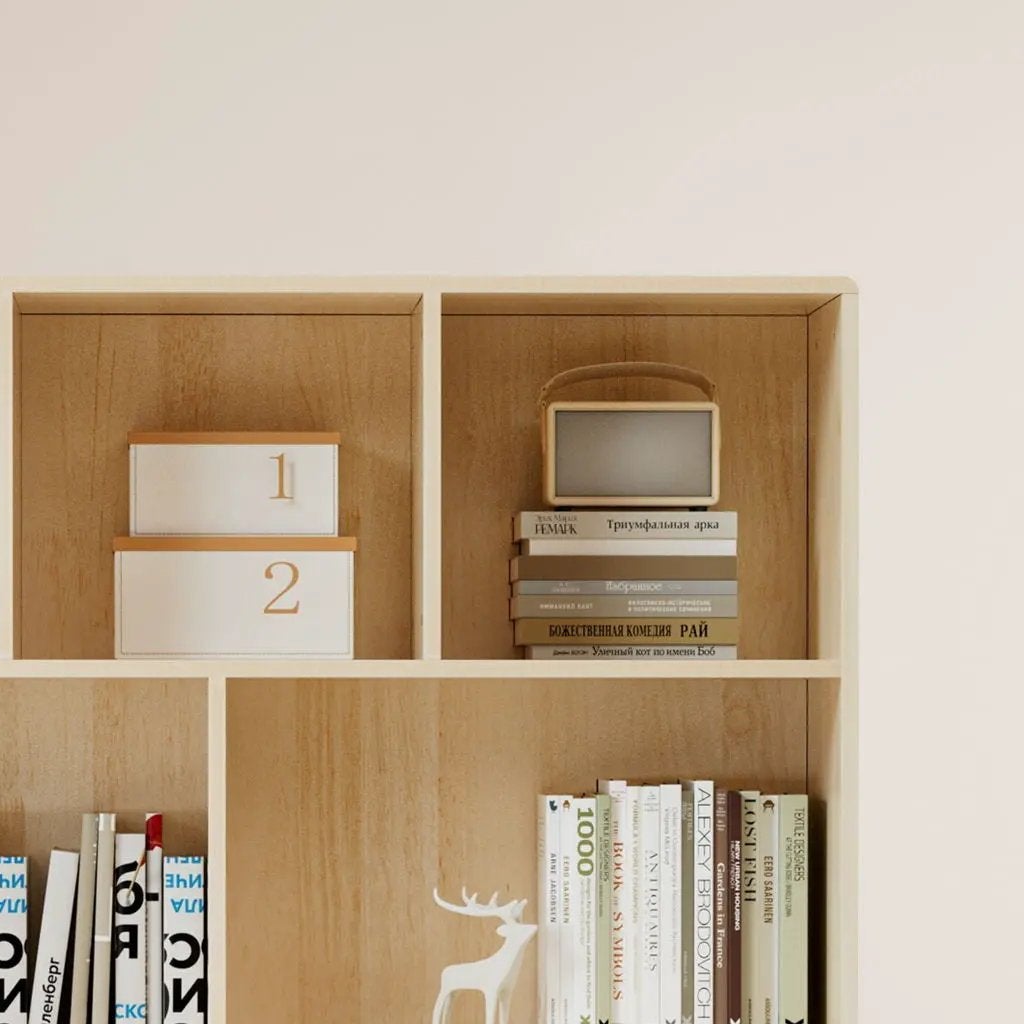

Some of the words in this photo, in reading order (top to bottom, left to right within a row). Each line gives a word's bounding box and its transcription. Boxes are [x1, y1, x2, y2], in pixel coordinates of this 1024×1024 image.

[269, 453, 293, 500] 1
[606, 519, 690, 533] Триумфальная
[694, 522, 720, 533] арка
[264, 562, 300, 615] 2
[548, 624, 624, 637] БОЖЕСТВЕННАЯ
[626, 624, 672, 637] КОМЕДИЯ
[680, 621, 709, 638] РАЙ
[592, 645, 633, 657] Уличный
[635, 648, 651, 656] кот
[667, 648, 696, 656] имени
[697, 645, 716, 657] Боб
[576, 807, 594, 877] 1000
[698, 787, 711, 873] ALEXEY
[744, 799, 757, 852] LOST
[793, 808, 805, 837] TEXTILE
[613, 842, 624, 892] BOOK
[744, 857, 757, 903] FISH
[763, 856, 774, 878] EERO
[793, 839, 805, 882] DESIGNERS
[716, 862, 726, 912] Gardens
[763, 881, 774, 924] SAARINEN
[647, 849, 658, 972] ANTIQUAIRES
[716, 914, 726, 926] in
[613, 912, 624, 1001] SYMBOLS
[698, 879, 711, 1019] BRODOVITCH
[716, 929, 726, 969] France
